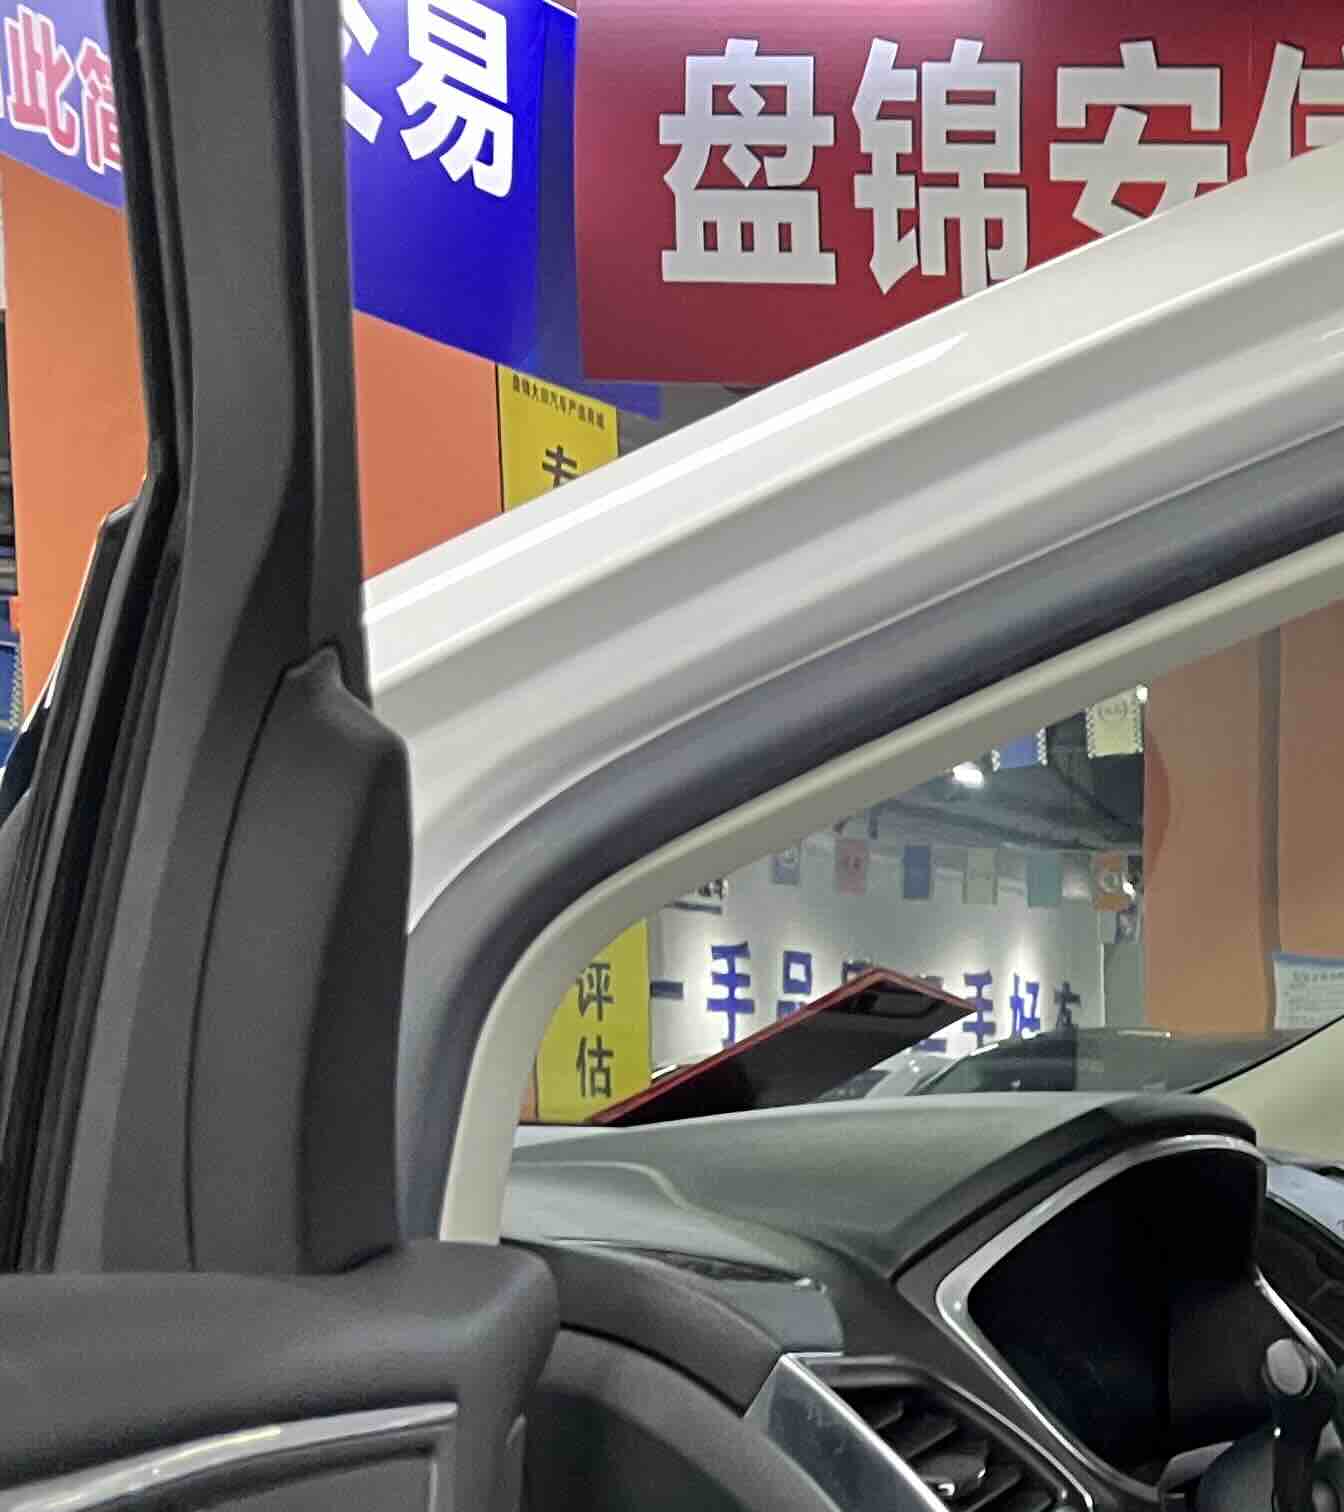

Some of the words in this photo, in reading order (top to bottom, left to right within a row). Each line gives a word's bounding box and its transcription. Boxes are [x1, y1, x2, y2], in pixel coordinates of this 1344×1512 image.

[575, 961, 615, 1099] 评估
[649, 942, 872, 1050] 一手品
